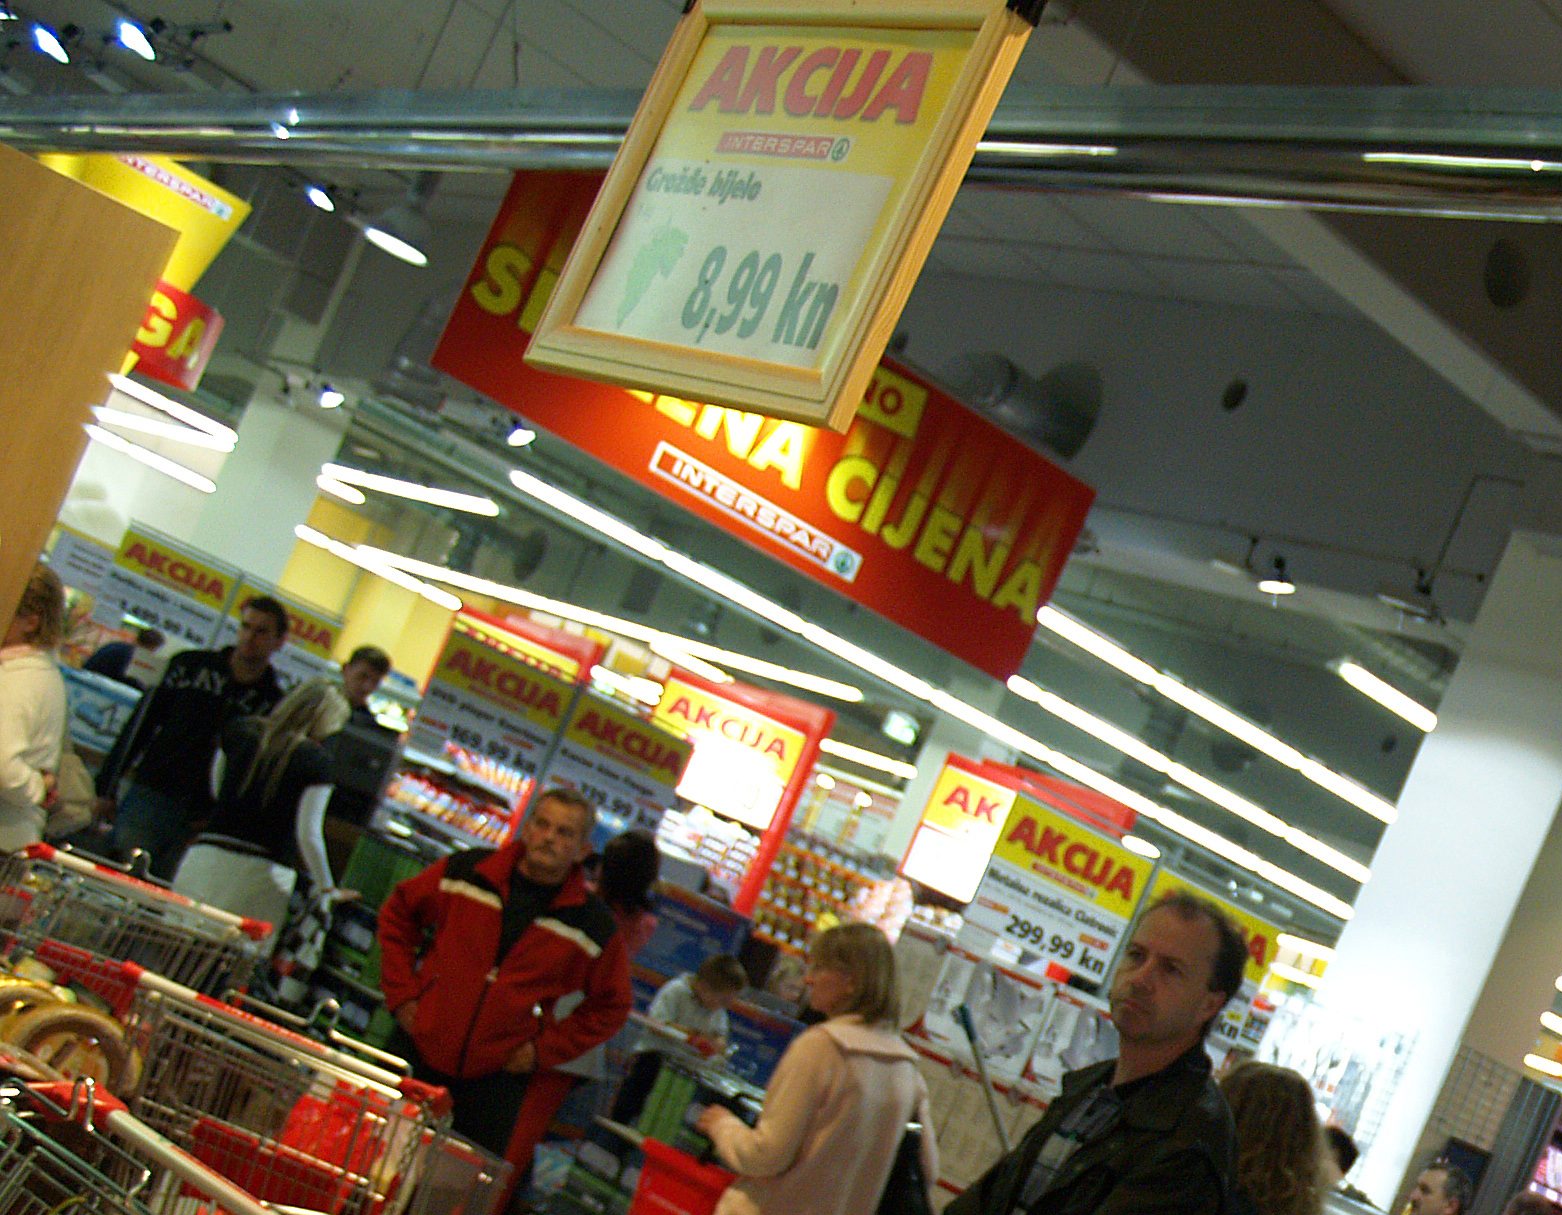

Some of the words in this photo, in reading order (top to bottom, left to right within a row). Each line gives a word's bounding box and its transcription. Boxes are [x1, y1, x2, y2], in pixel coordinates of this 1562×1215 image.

[688, 46, 933, 125] AKCIJA
[727, 136, 831, 157] INTERSPAR
[708, 170, 761, 204] bijelo
[681, 246, 783, 342] 8,99
[772, 252, 839, 350] kn
[672, 459, 833, 560] INTERSPAR
[826, 454, 1046, 625] CIJENA
[122, 542, 225, 601] AKCIJA
[450, 647, 560, 717] AKCIJA
[576, 710, 682, 774] AKCIJA
[668, 696, 787, 761] AKCIJA
[1007, 815, 1136, 901] AKCIJA
[1006, 914, 1075, 958] 299,99
[1078, 947, 1105, 974] kn
